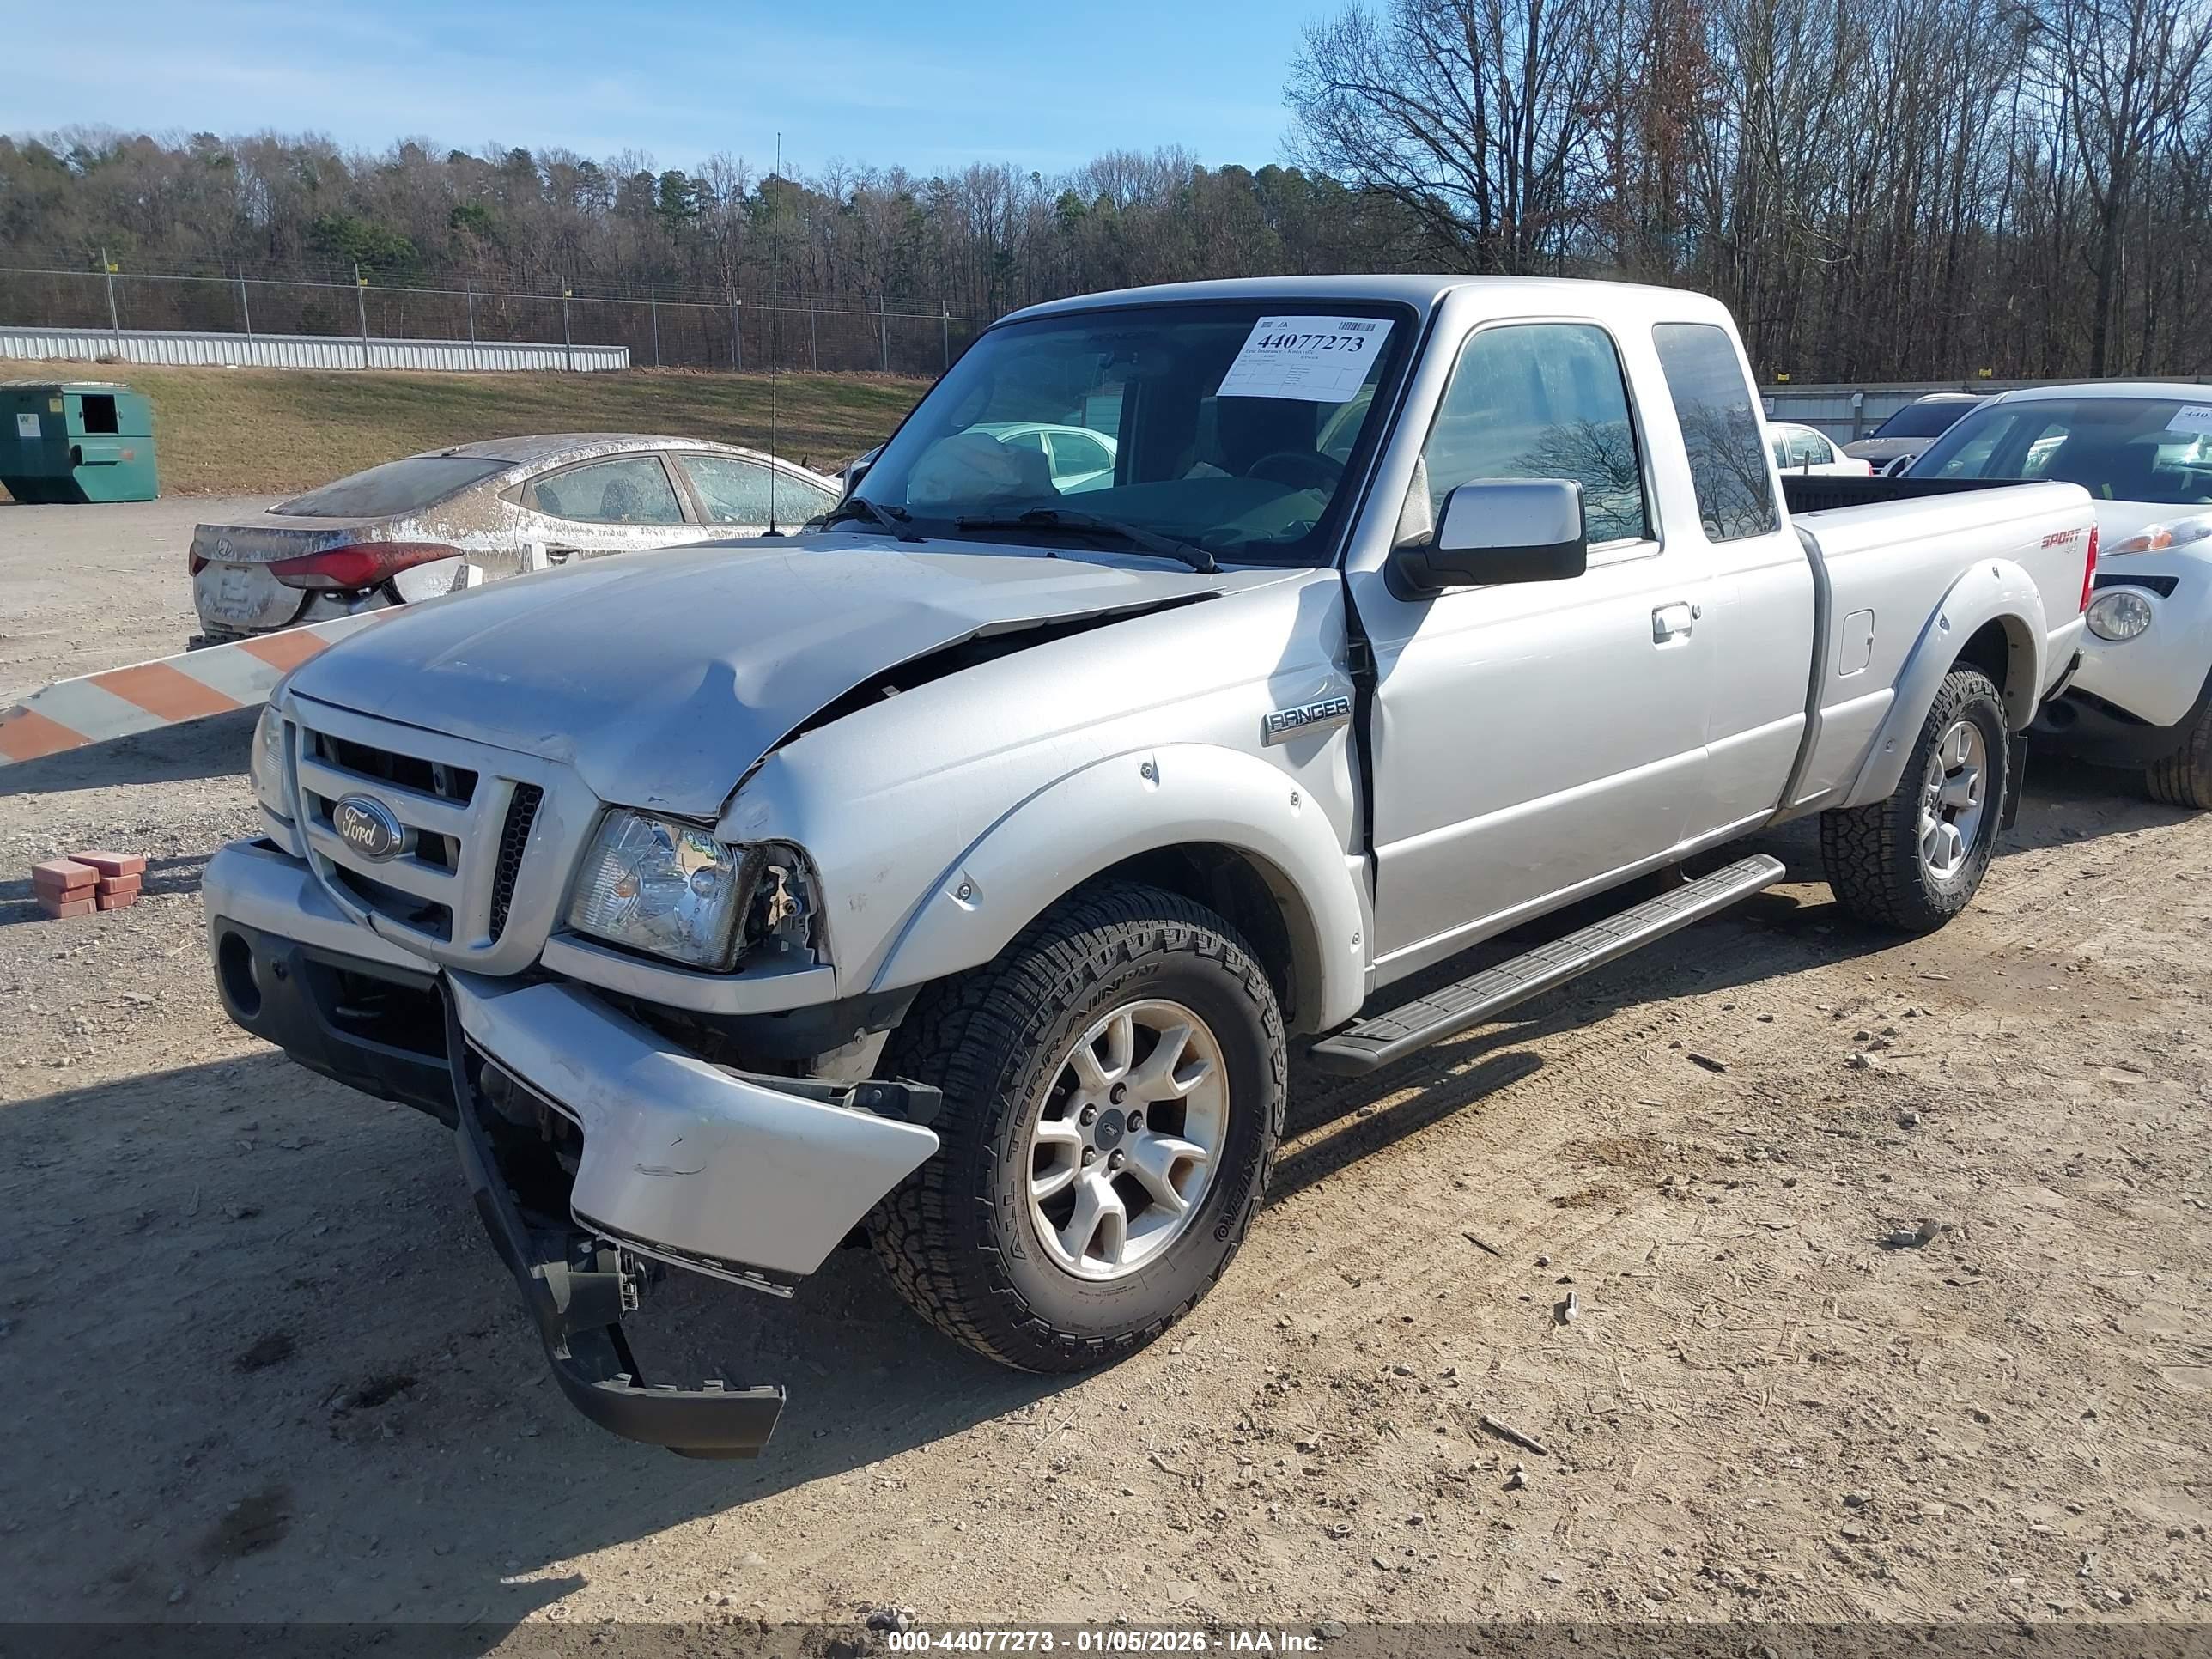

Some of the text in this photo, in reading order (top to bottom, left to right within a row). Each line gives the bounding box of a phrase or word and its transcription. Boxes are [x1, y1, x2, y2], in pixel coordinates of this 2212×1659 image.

[1257, 333, 1365, 352] 44077273
[2041, 528, 2081, 549] SPORT
[1269, 697, 1350, 730] RANGER
[343, 806, 377, 846] Ford
[1006, 976, 1121, 1163] TERRAIN
[1003, 1181, 1027, 1260] ALL
